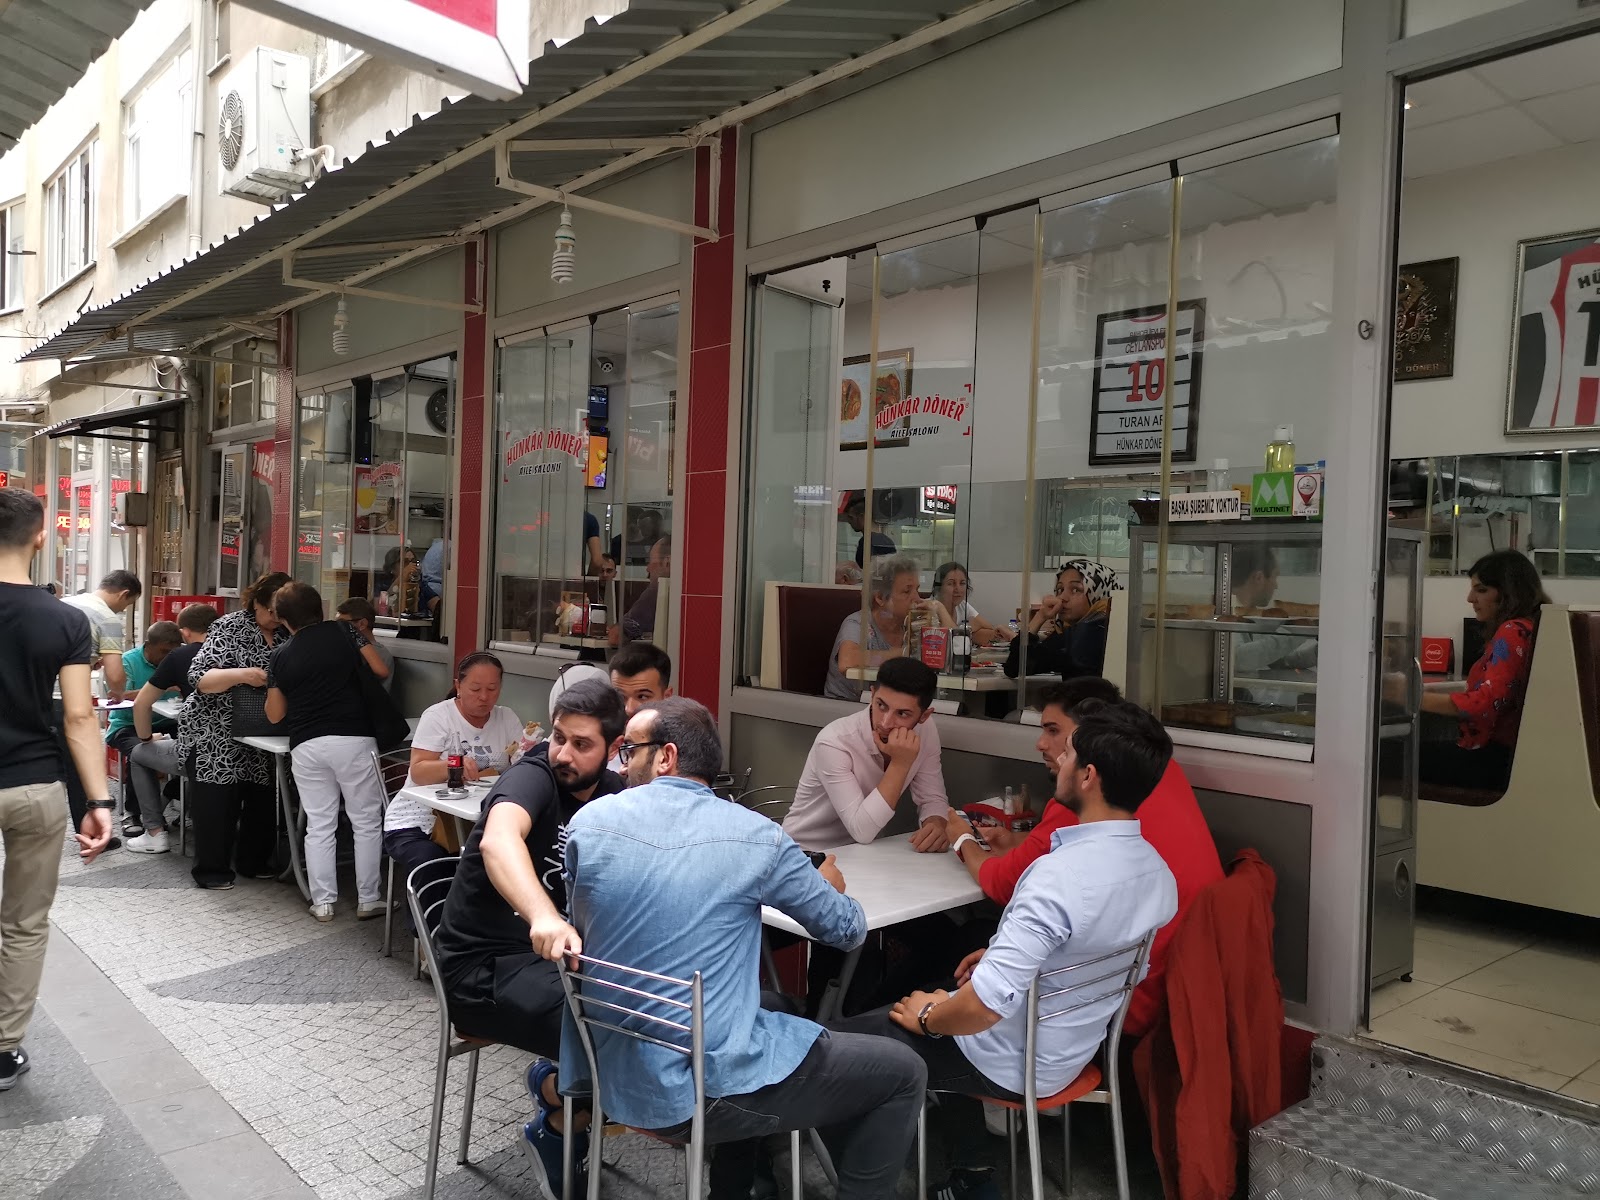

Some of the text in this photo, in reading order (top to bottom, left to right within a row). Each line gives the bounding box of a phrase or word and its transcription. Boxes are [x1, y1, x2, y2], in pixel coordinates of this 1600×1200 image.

[1125, 338, 1166, 353] CEYLANSPO
[1126, 358, 1166, 402] 10
[922, 394, 965, 421] DÖNER
[1119, 415, 1150, 428] TURAN
[908, 425, 940, 436] SALONU
[547, 427, 582, 458] DÖNER
[1116, 436, 1163, 450] HÜNKAR DÖNE
[534, 461, 562, 474] SALONU
[1171, 496, 1239, 519] BAŞKA ŞUBEMİZ YOKTUR
[1254, 505, 1290, 513] MULTINET
